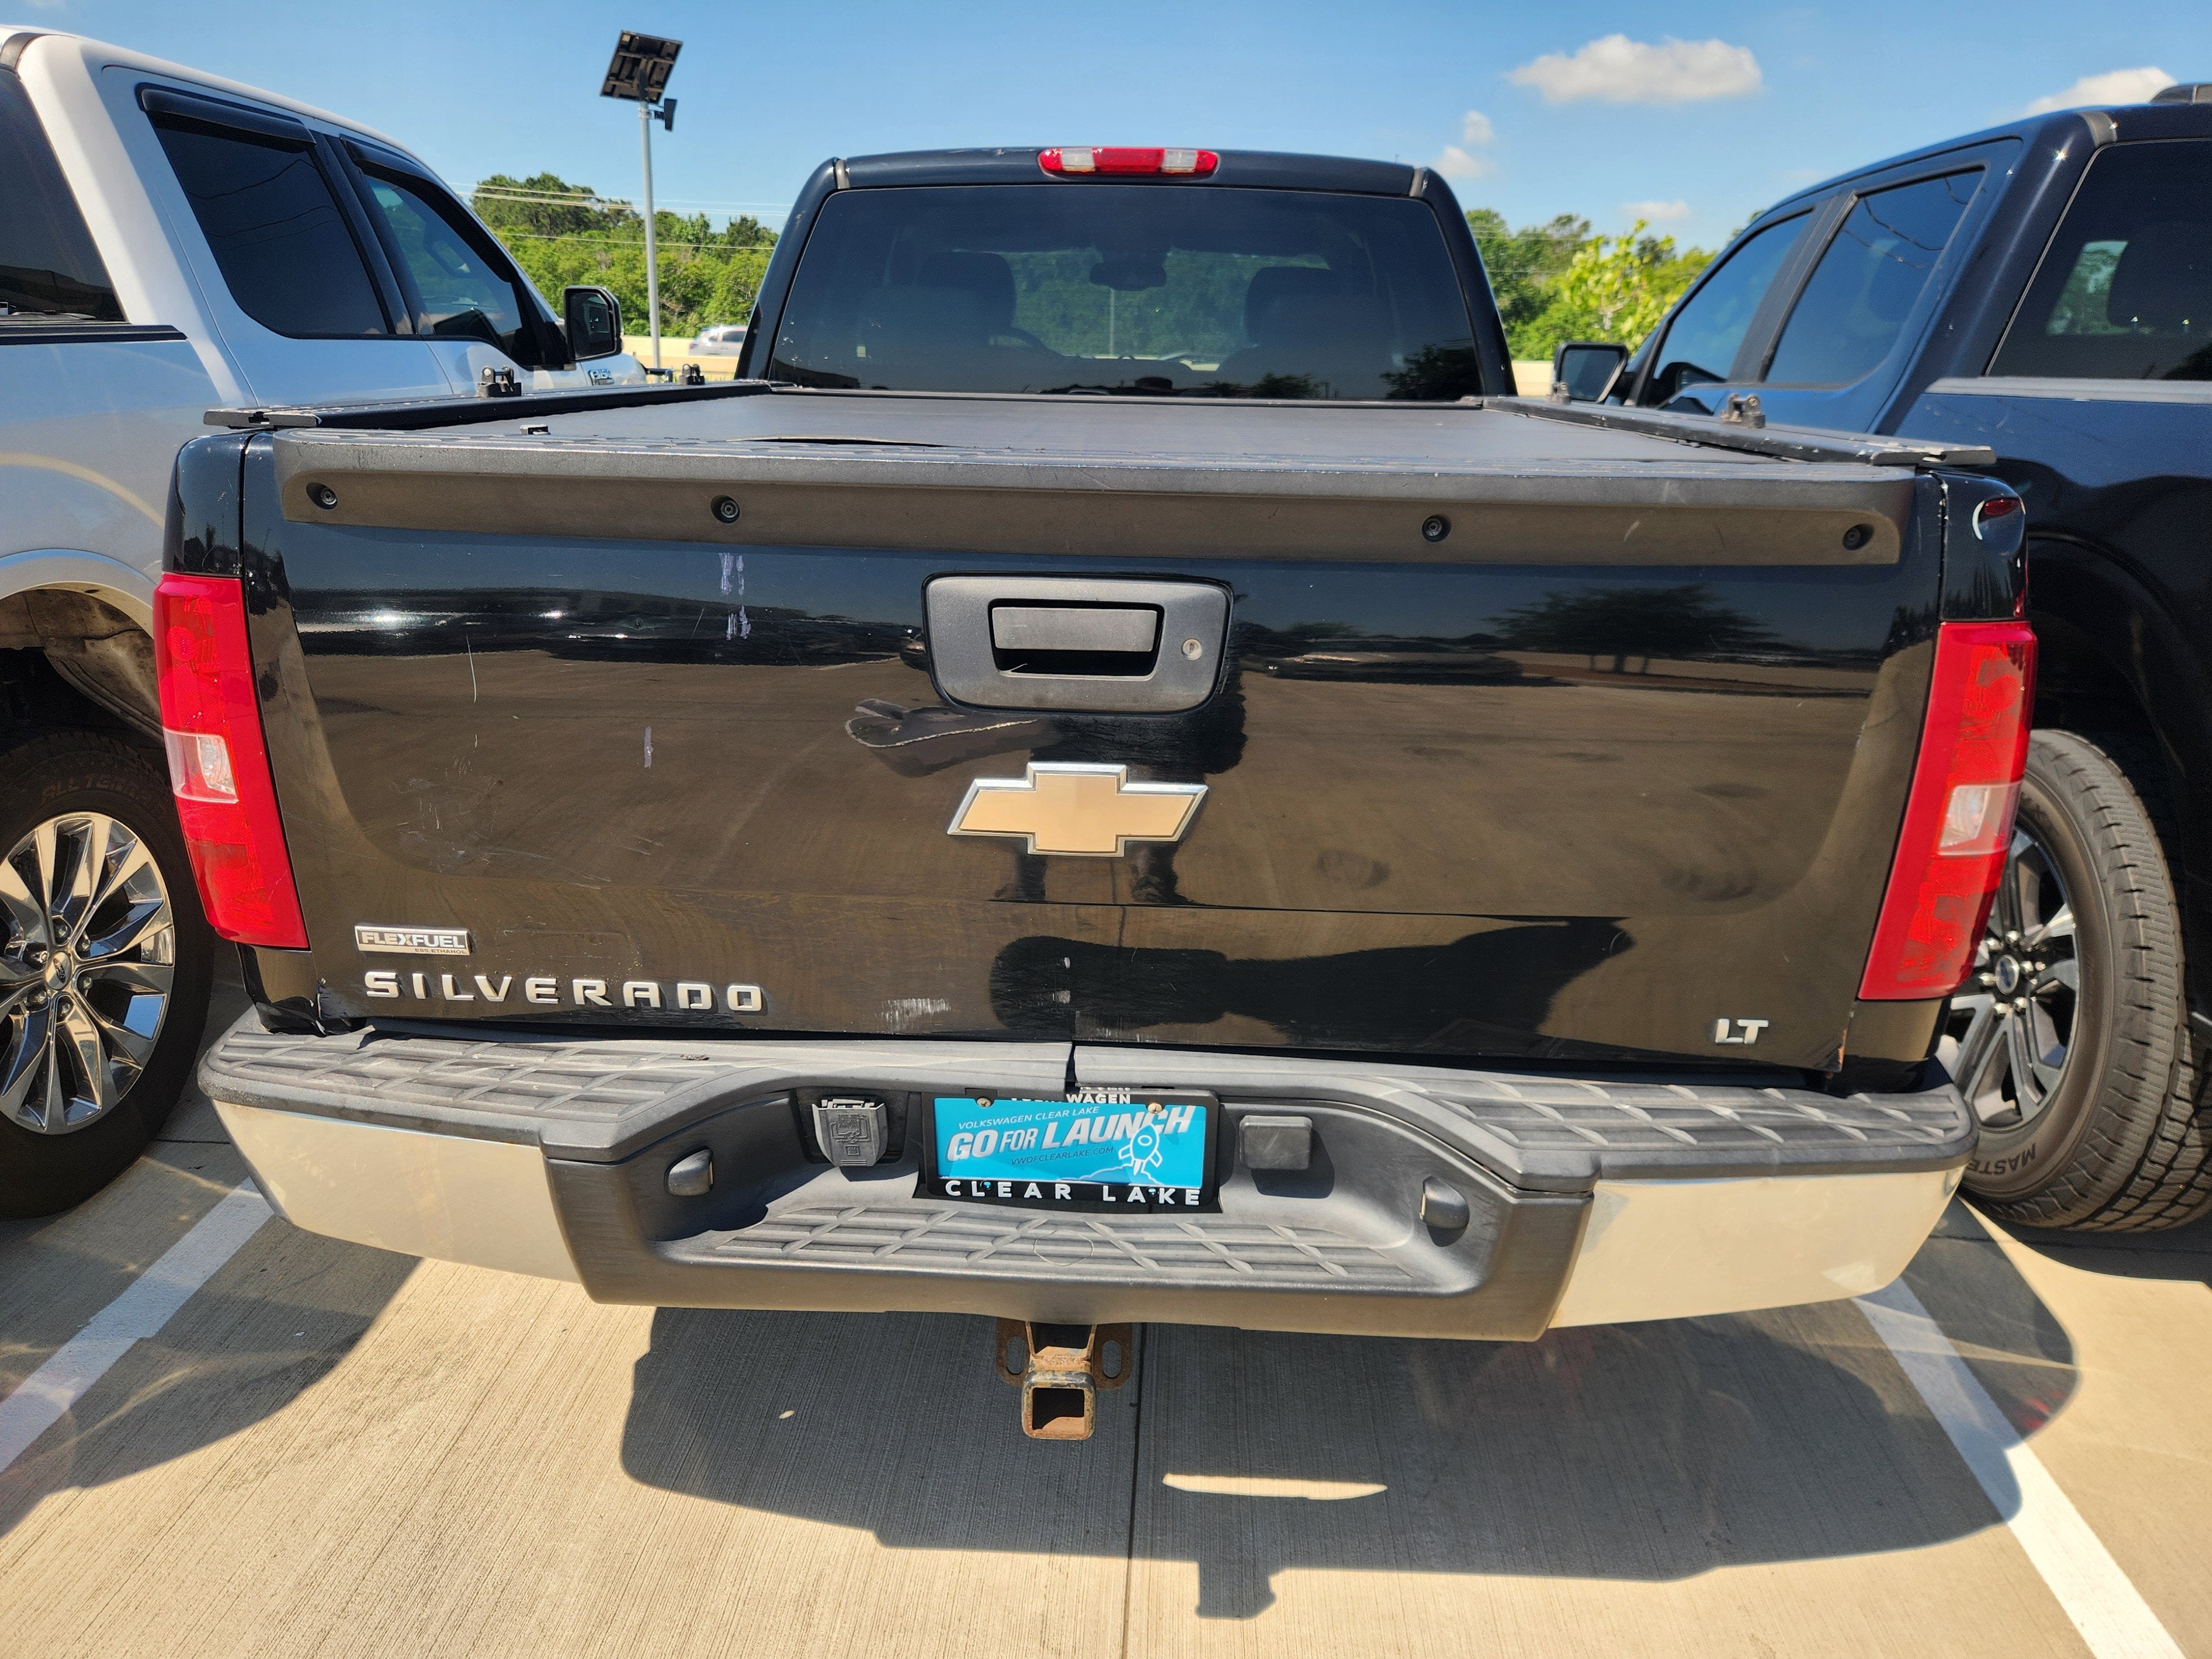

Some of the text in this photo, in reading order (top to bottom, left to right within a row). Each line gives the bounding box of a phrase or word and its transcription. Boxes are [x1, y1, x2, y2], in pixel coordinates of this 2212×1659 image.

[361, 931, 465, 948] FLEXFUEL
[364, 971, 763, 1011] SILVERADO
[1715, 1018, 1769, 1045] LT
[958, 1106, 1100, 1129] VOLKSWAGEN CLEAR LAKE
[947, 1105, 1196, 1161] GO FOR LAUNCH
[1011, 1146, 1114, 1165] VWOFCLEARLAKE.COM
[1966, 1142, 2036, 1174] MASTE
[945, 1180, 1201, 1206] CLEAR LAKE
